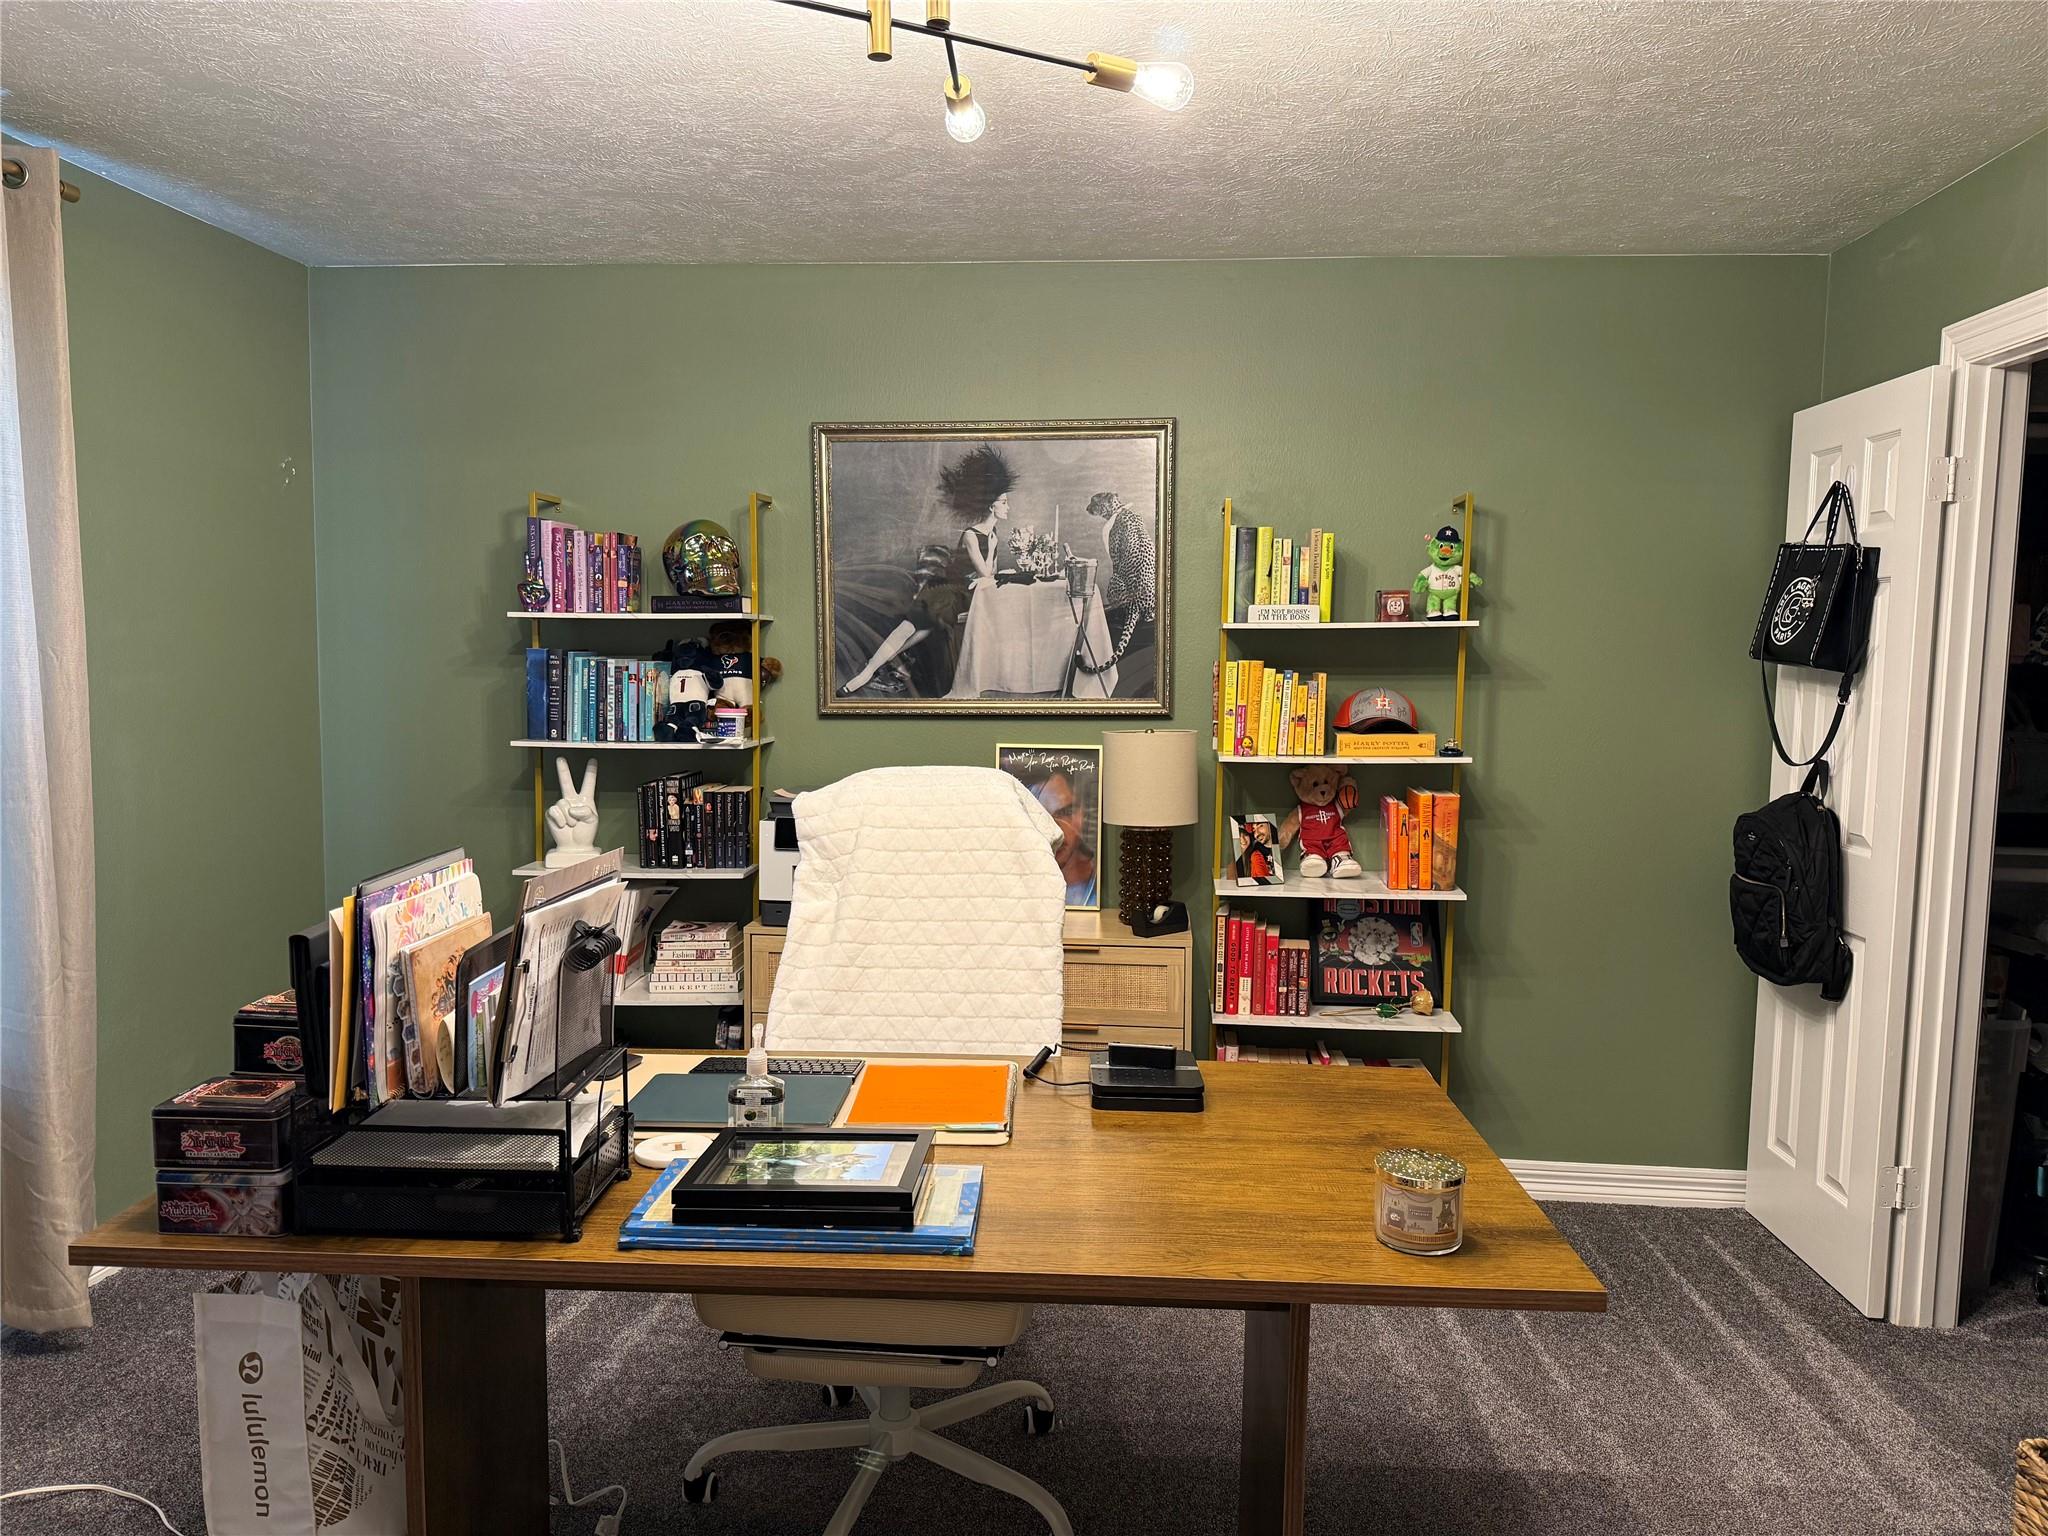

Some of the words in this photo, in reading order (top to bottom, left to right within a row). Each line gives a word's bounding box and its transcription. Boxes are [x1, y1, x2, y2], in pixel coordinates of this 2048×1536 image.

[1774, 628, 1792, 641] PARIS
[680, 678, 686, 694] 1
[672, 950, 695, 958] Fashion
[1229, 977, 1237, 1001] GREAT
[1323, 967, 1424, 997] ROCKETS
[306, 1364, 335, 1433] Dance
[316, 1389, 342, 1440] Sing
[242, 1393, 271, 1517] lululemon
